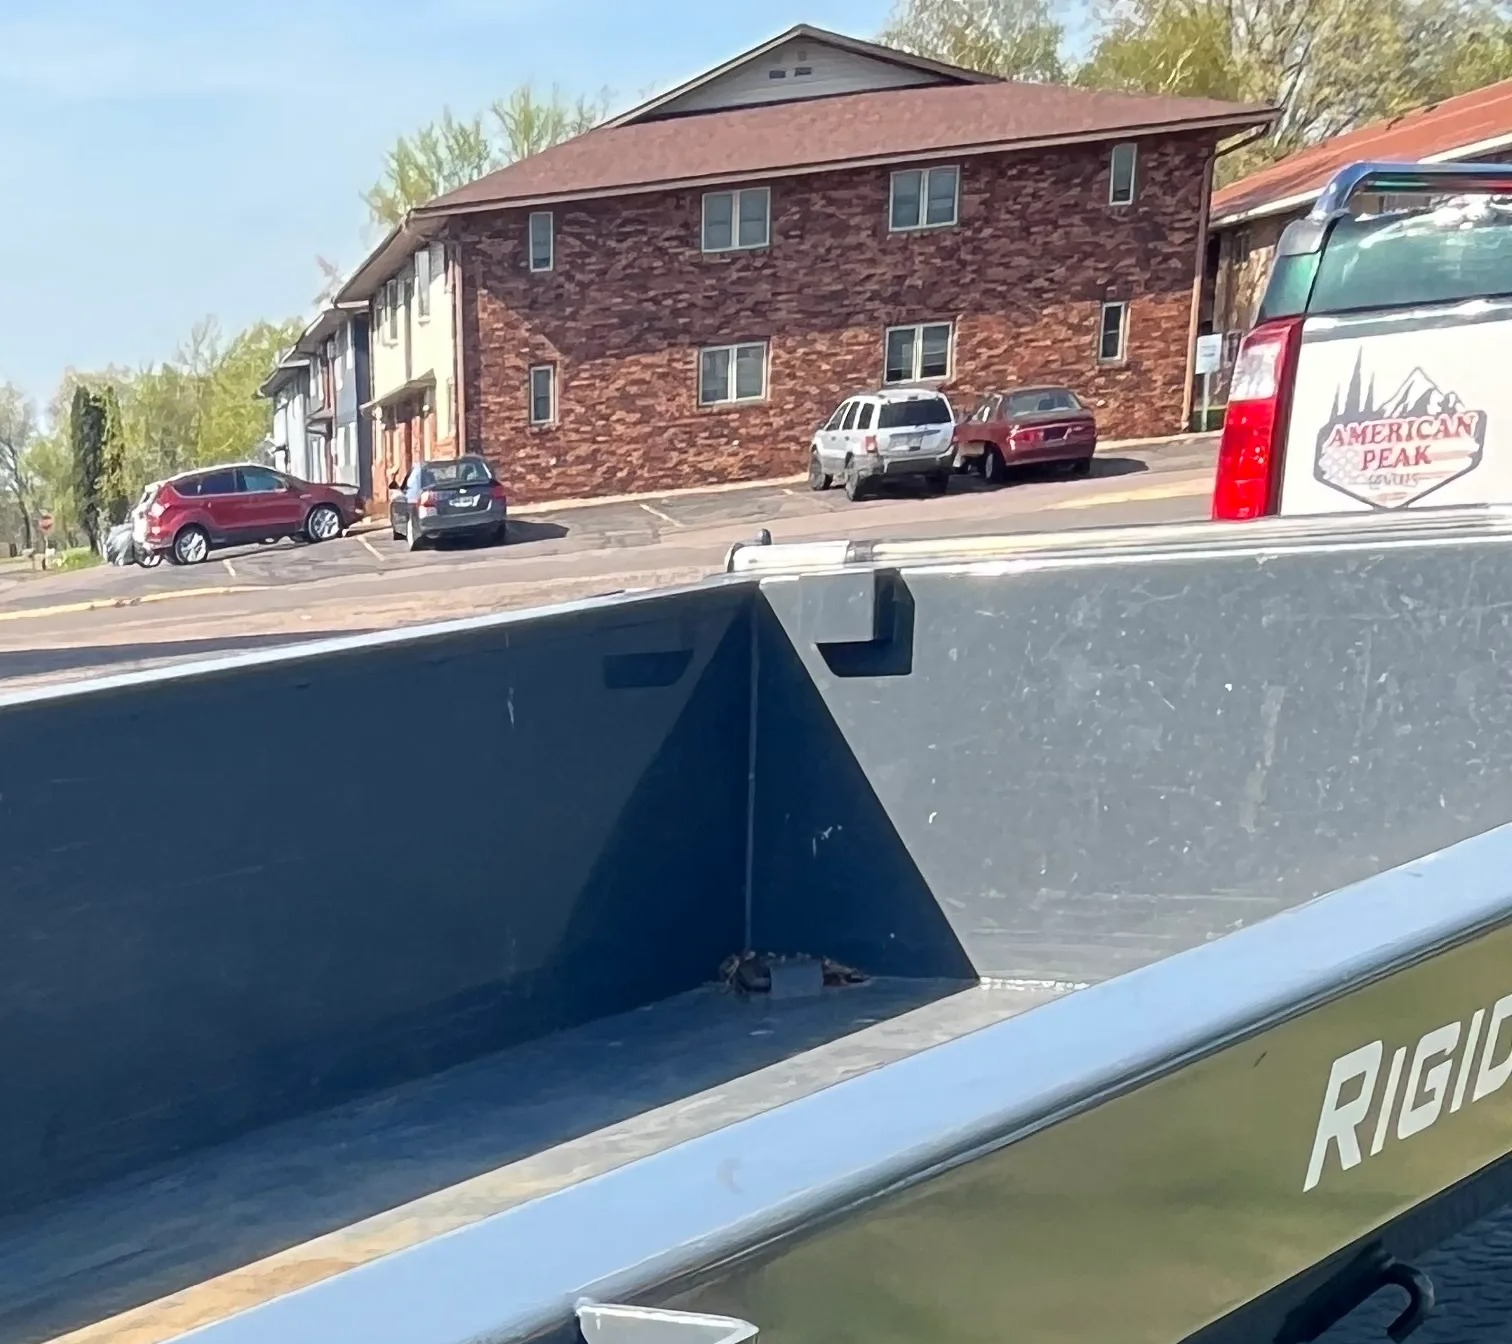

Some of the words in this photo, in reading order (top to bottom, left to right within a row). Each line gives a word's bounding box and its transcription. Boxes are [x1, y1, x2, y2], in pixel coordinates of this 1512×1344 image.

[1328, 414, 1474, 447] AMERICAN
[1361, 445, 1432, 471] PEAK
[1303, 993, 1512, 1193] RIGID
